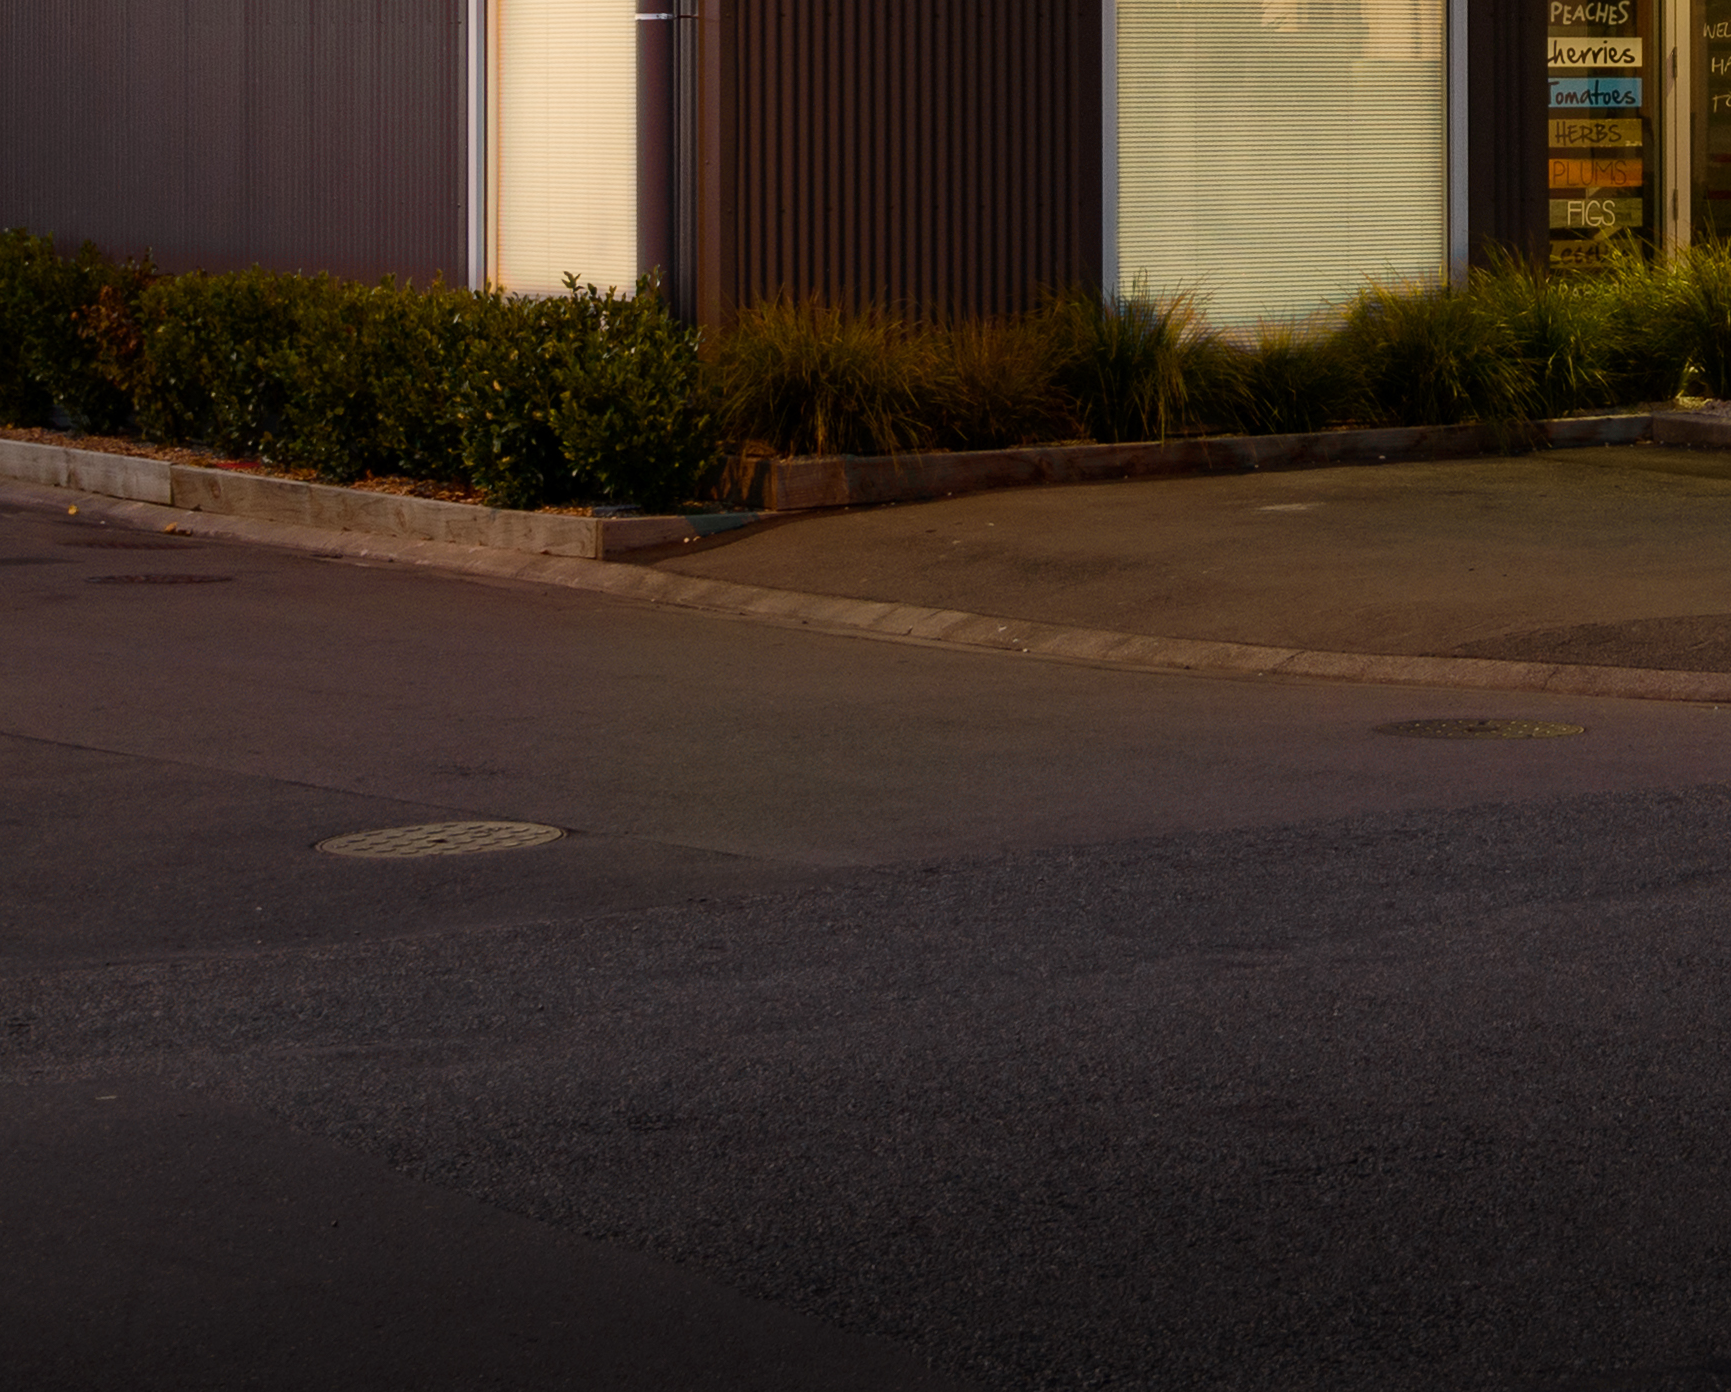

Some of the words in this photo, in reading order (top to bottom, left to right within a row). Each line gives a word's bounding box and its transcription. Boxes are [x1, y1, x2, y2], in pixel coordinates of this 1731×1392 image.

[1550, 0, 1630, 26] PEACHES
[1548, 40, 1635, 65] herries
[1555, 119, 1622, 145] HERBS
[1553, 161, 1627, 186] PLUMS
[1567, 199, 1615, 227] FIGS
